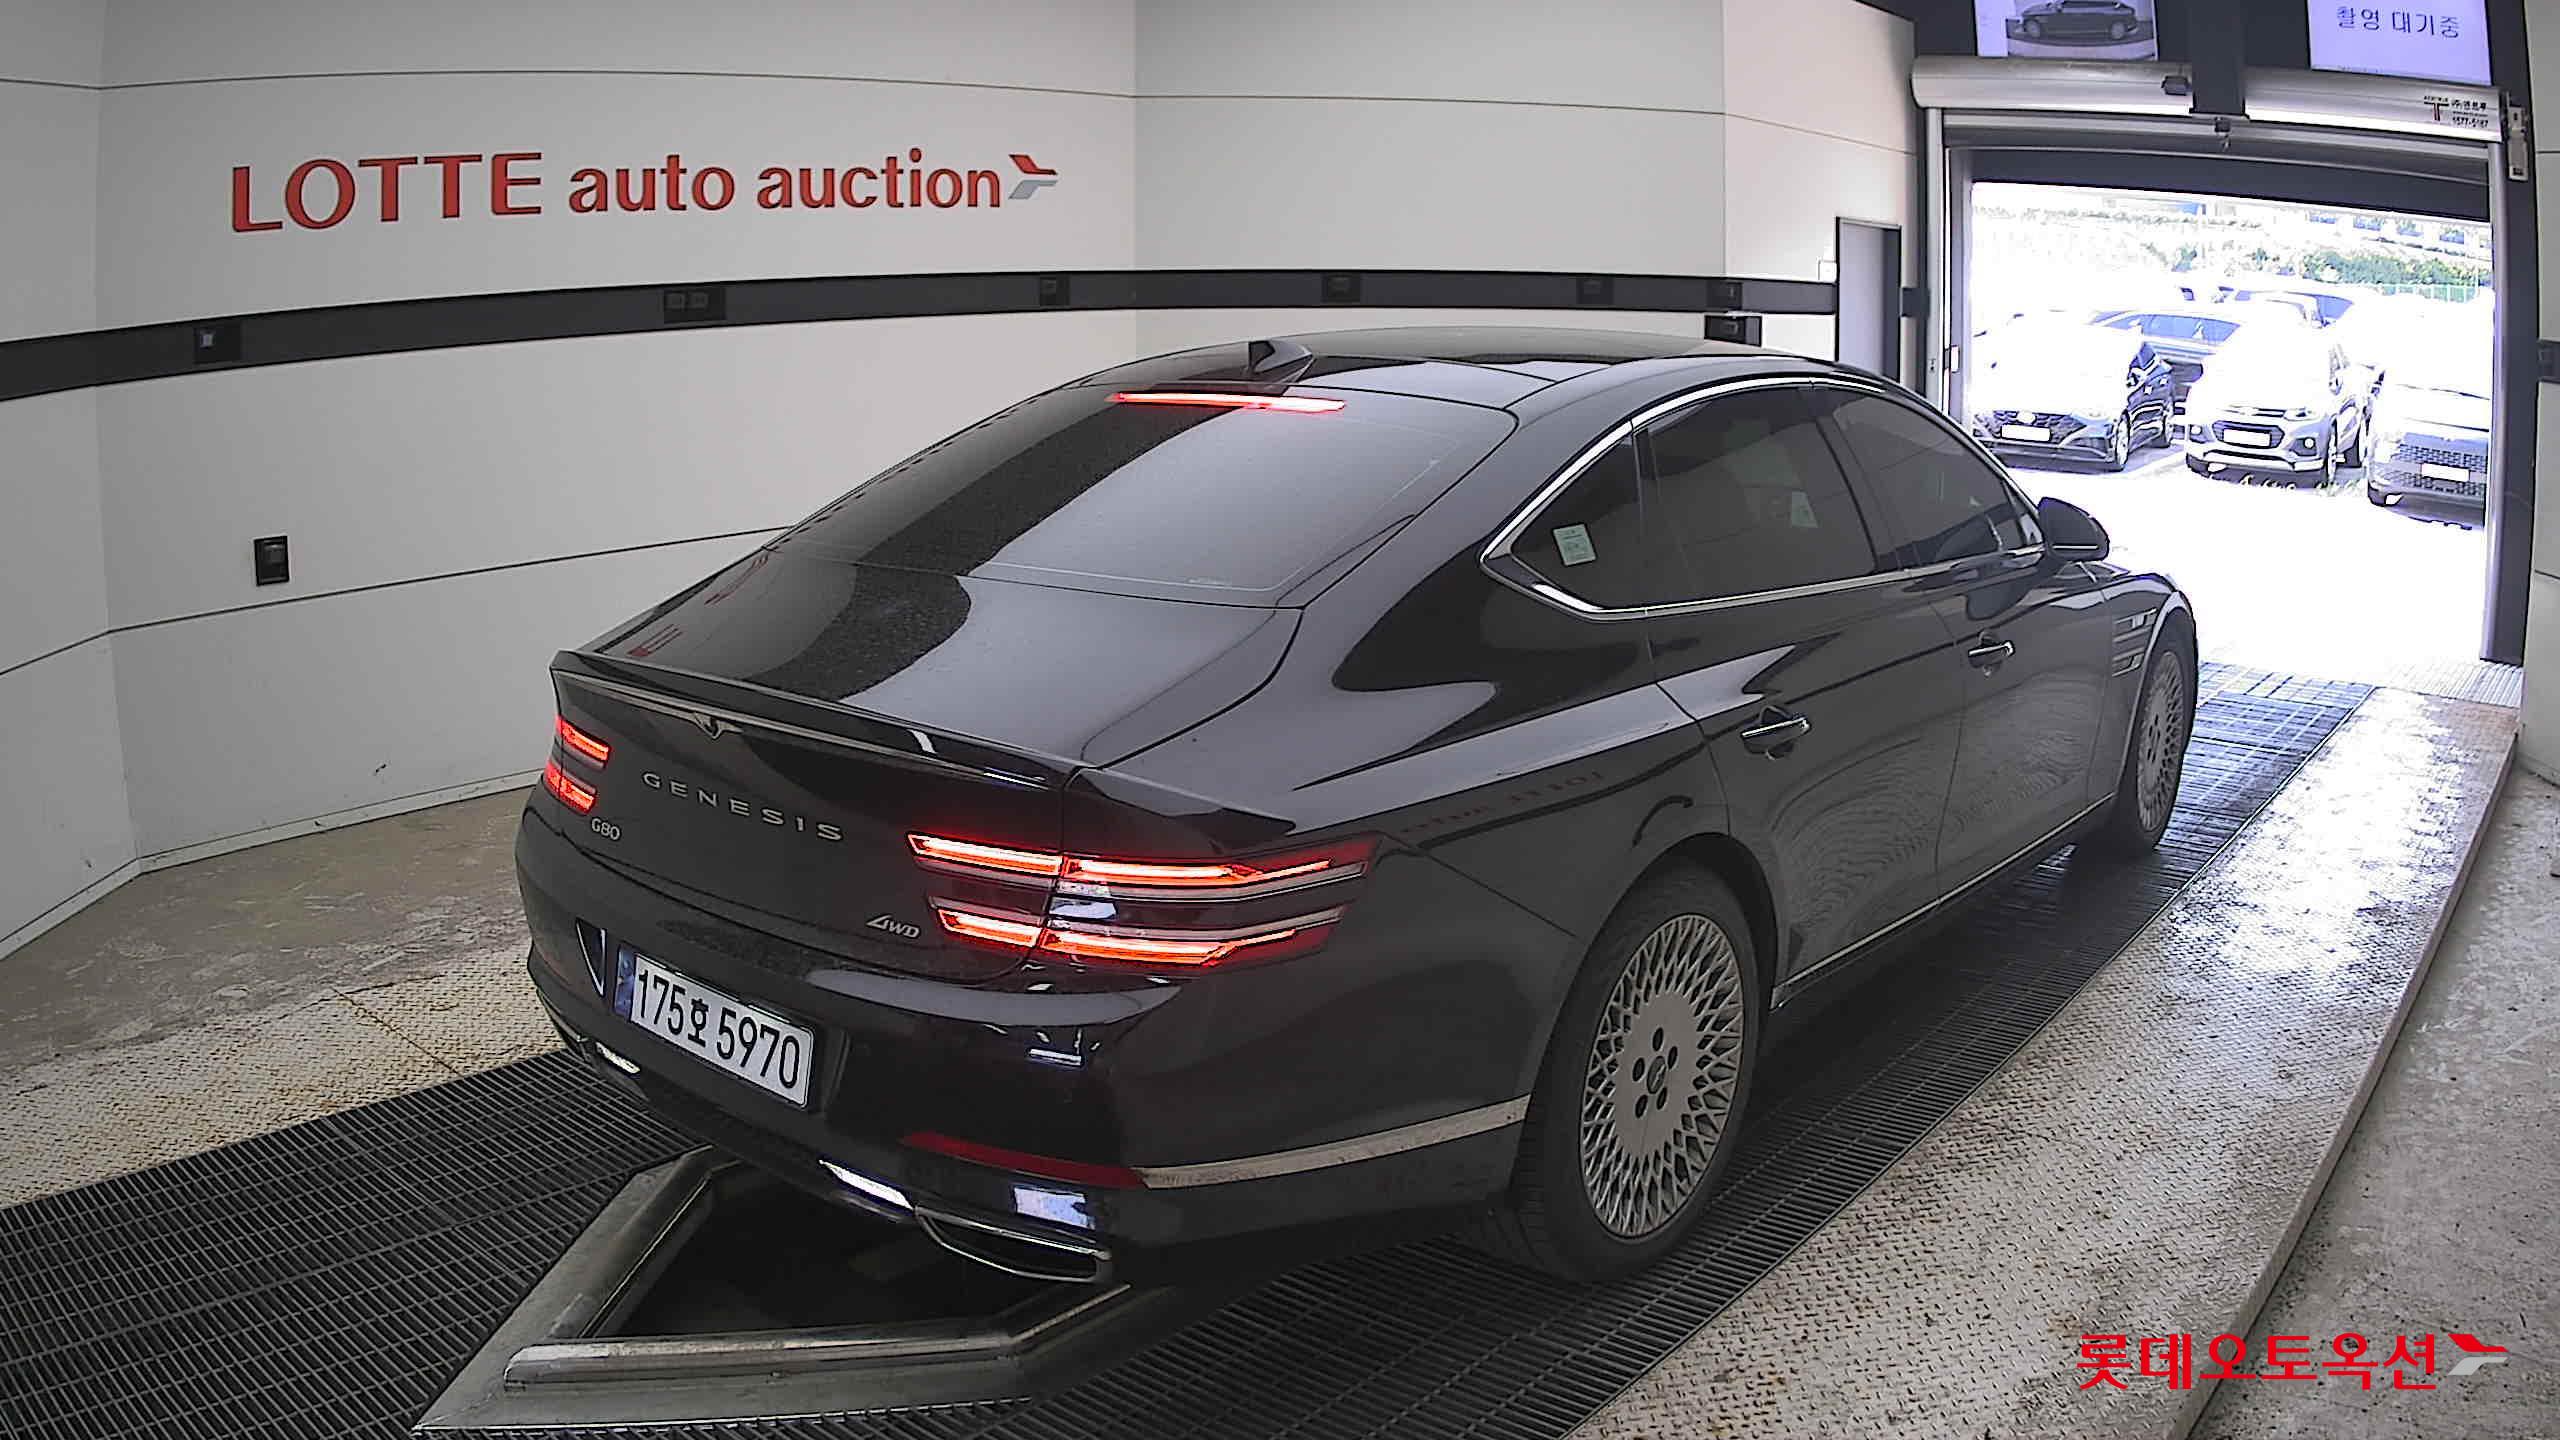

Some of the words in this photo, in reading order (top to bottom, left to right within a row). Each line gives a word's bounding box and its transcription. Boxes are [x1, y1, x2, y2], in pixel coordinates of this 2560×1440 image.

[2337, 6, 2380, 31] 촬영
[2391, 11, 2459, 38] 대기중
[231, 152, 542, 233] LOTTE
[568, 154, 736, 214] auto
[757, 147, 1002, 210] auction
[590, 817, 621, 842] G80
[642, 771, 844, 842] GENESIS
[638, 969, 709, 1048] 175호
[716, 1006, 800, 1089] 5970
